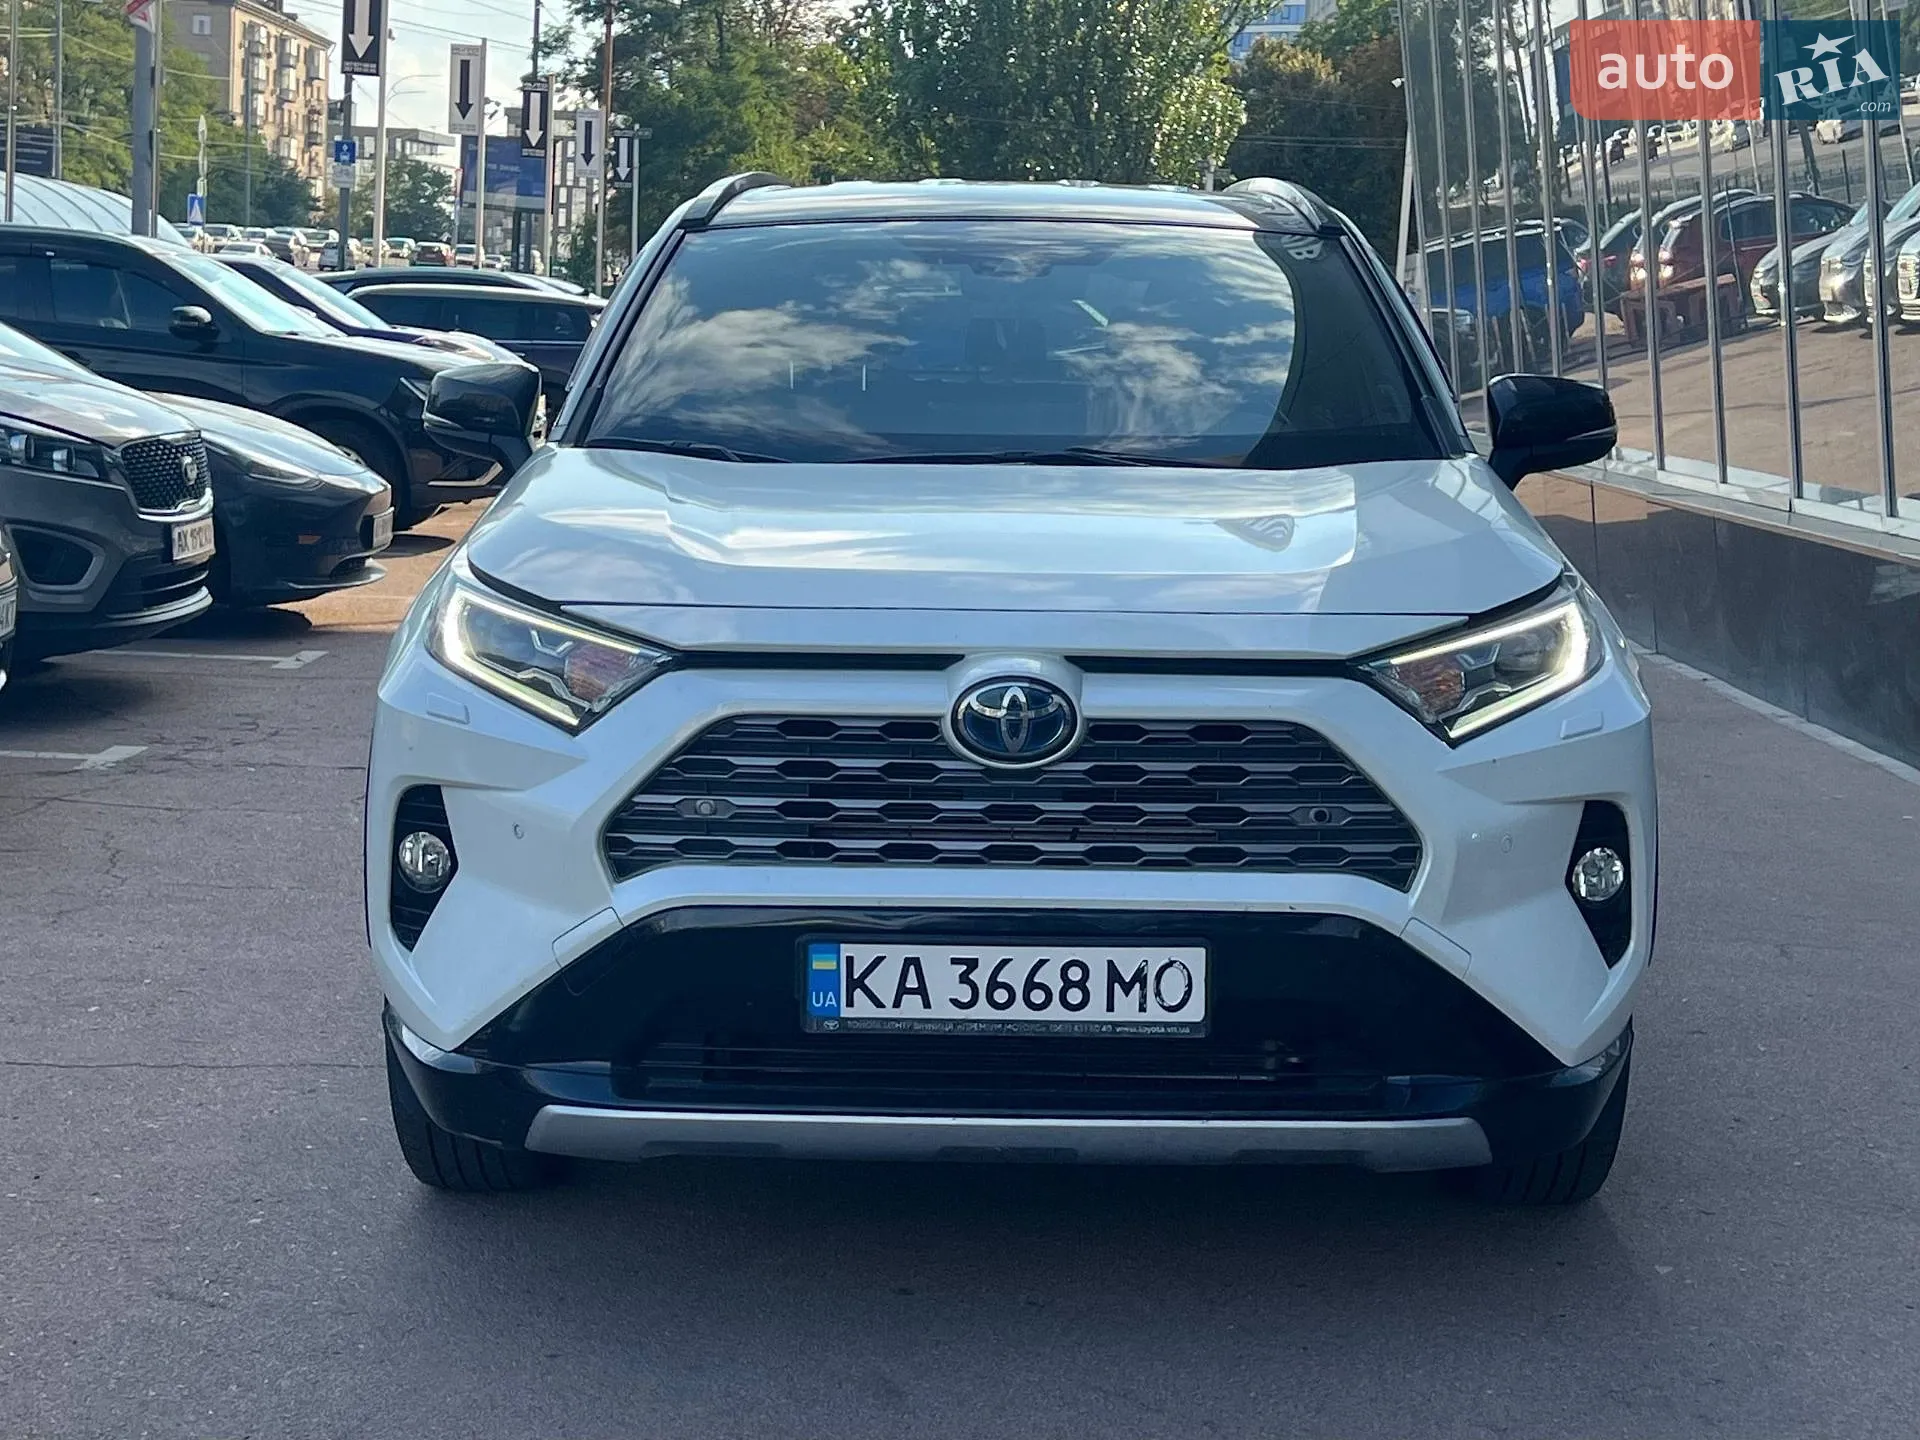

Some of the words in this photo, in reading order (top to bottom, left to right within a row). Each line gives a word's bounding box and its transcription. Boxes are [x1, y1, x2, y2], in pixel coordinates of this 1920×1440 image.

[812, 991, 837, 1008] UA
[845, 955, 932, 1009] KA
[948, 957, 1090, 1012] 3668
[1106, 956, 1194, 1014] MO
